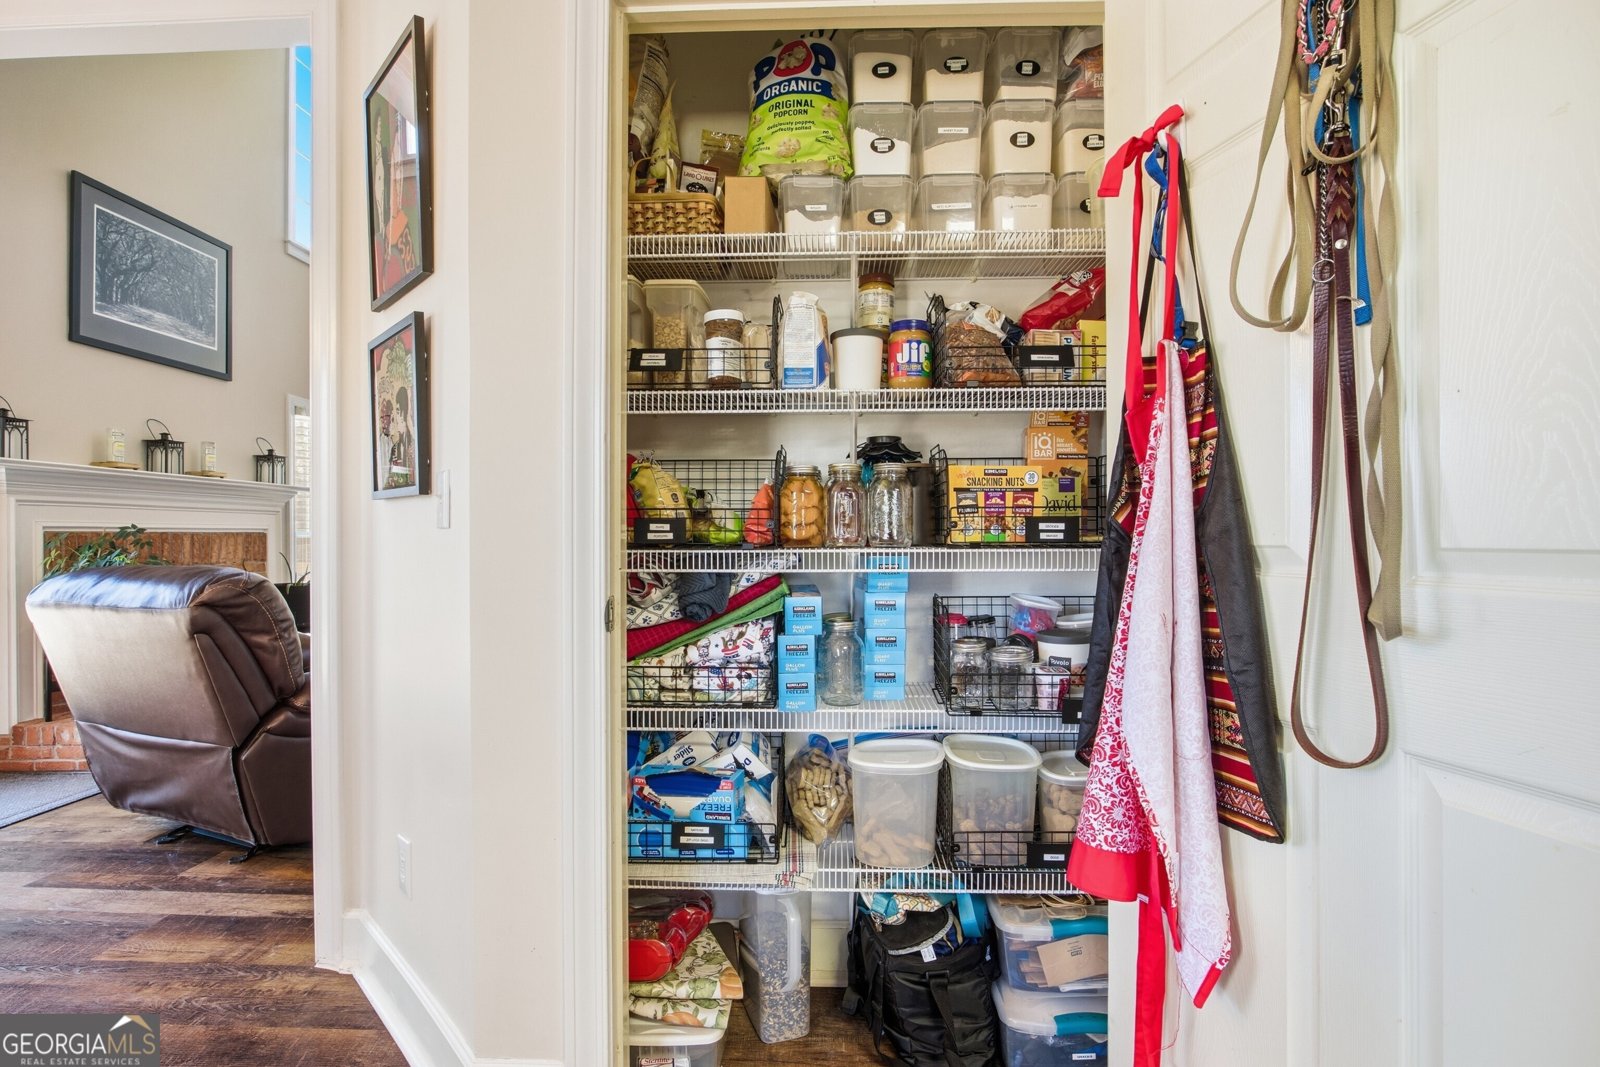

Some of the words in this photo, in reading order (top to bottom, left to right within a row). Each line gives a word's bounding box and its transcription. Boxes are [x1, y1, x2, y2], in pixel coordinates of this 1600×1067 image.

[763, 79, 822, 100] ORGANIC
[768, 99, 815, 113] ORIGINAL
[774, 109, 808, 119] POPCORN
[896, 341, 930, 364] Jif
[1034, 435, 1052, 450] IQ
[1034, 449, 1053, 458] BAR
[966, 477, 1003, 487] SNACKING
[1005, 476, 1025, 487] NUTS
[1050, 658, 1070, 667] Tovolo
[672, 744, 695, 761] Slider
[695, 804, 732, 812] FREEZE
